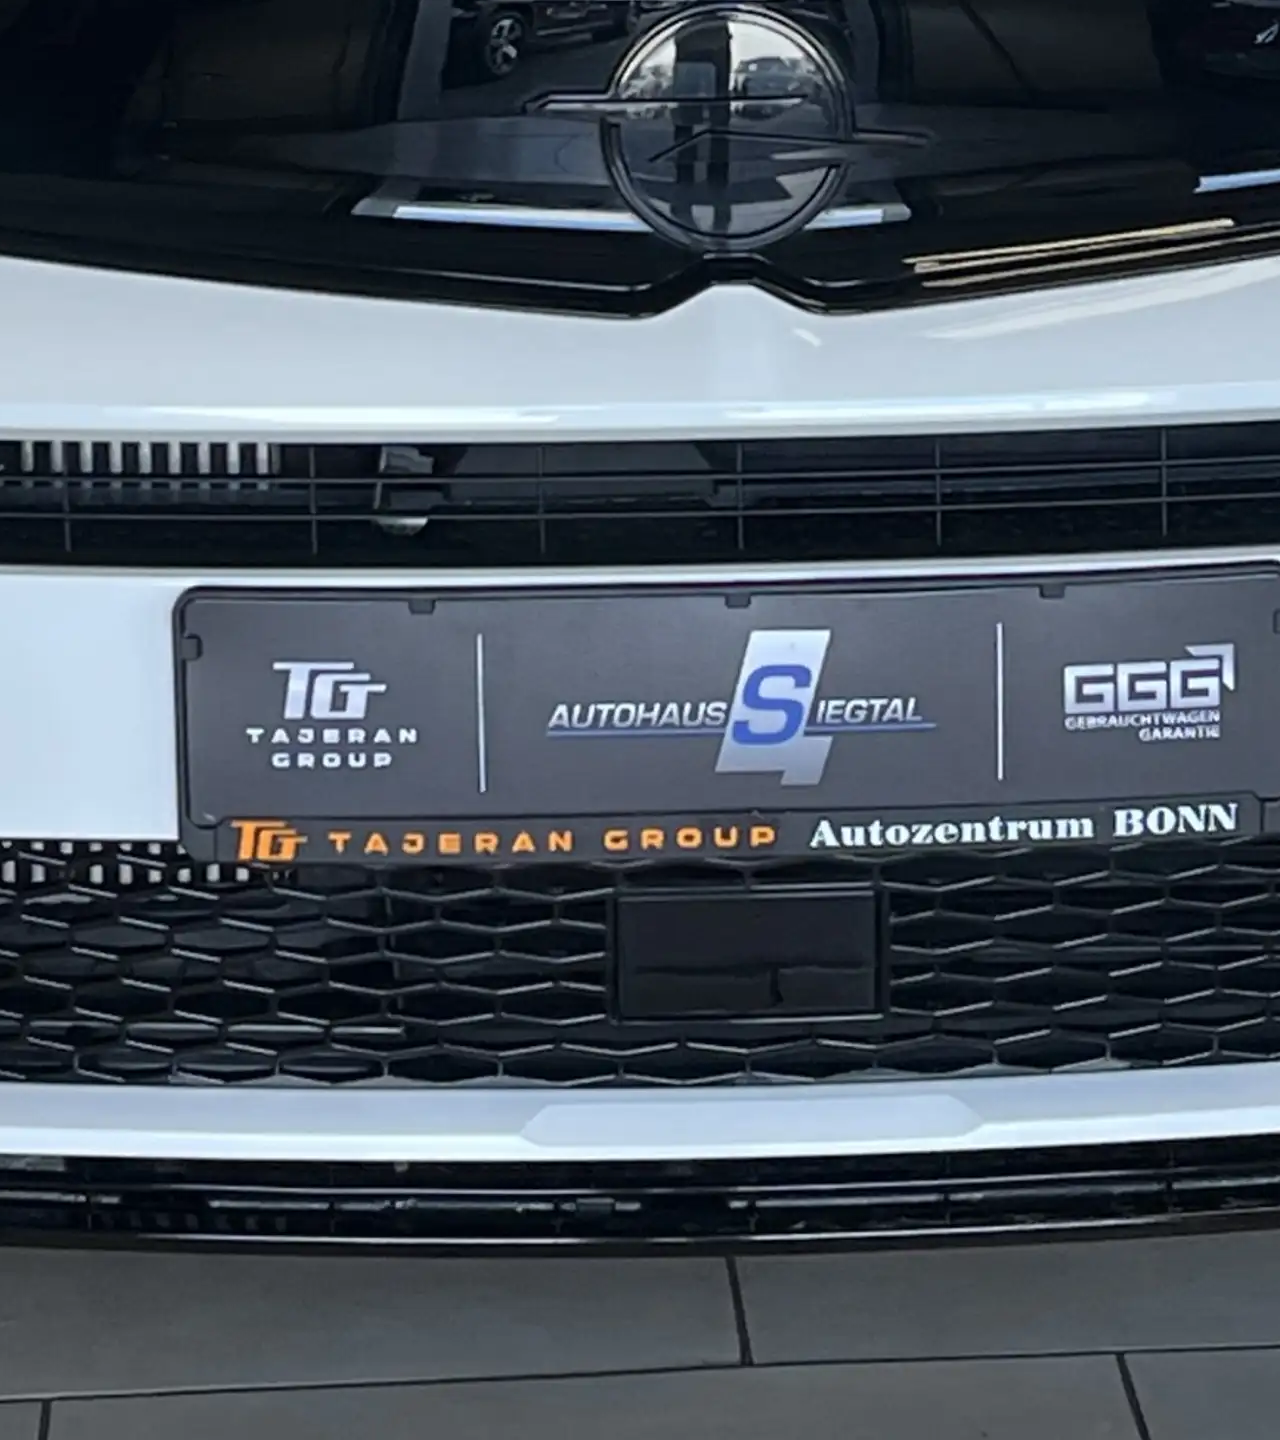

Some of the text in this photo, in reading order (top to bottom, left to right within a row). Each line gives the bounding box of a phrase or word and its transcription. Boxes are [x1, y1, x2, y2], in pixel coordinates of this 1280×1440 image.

[273, 662, 387, 720] TG
[1064, 658, 1220, 715] GGG
[548, 701, 728, 729] AUTOHAUS
[1064, 710, 1220, 731] GEBRAUCHTWAGEN
[245, 728, 417, 744] TAJERAN
[1138, 724, 1220, 742] GARANTIE
[271, 752, 392, 769] GROUP
[230, 803, 1239, 862] TG TAJERAN GROUP Autozentrum BONN
